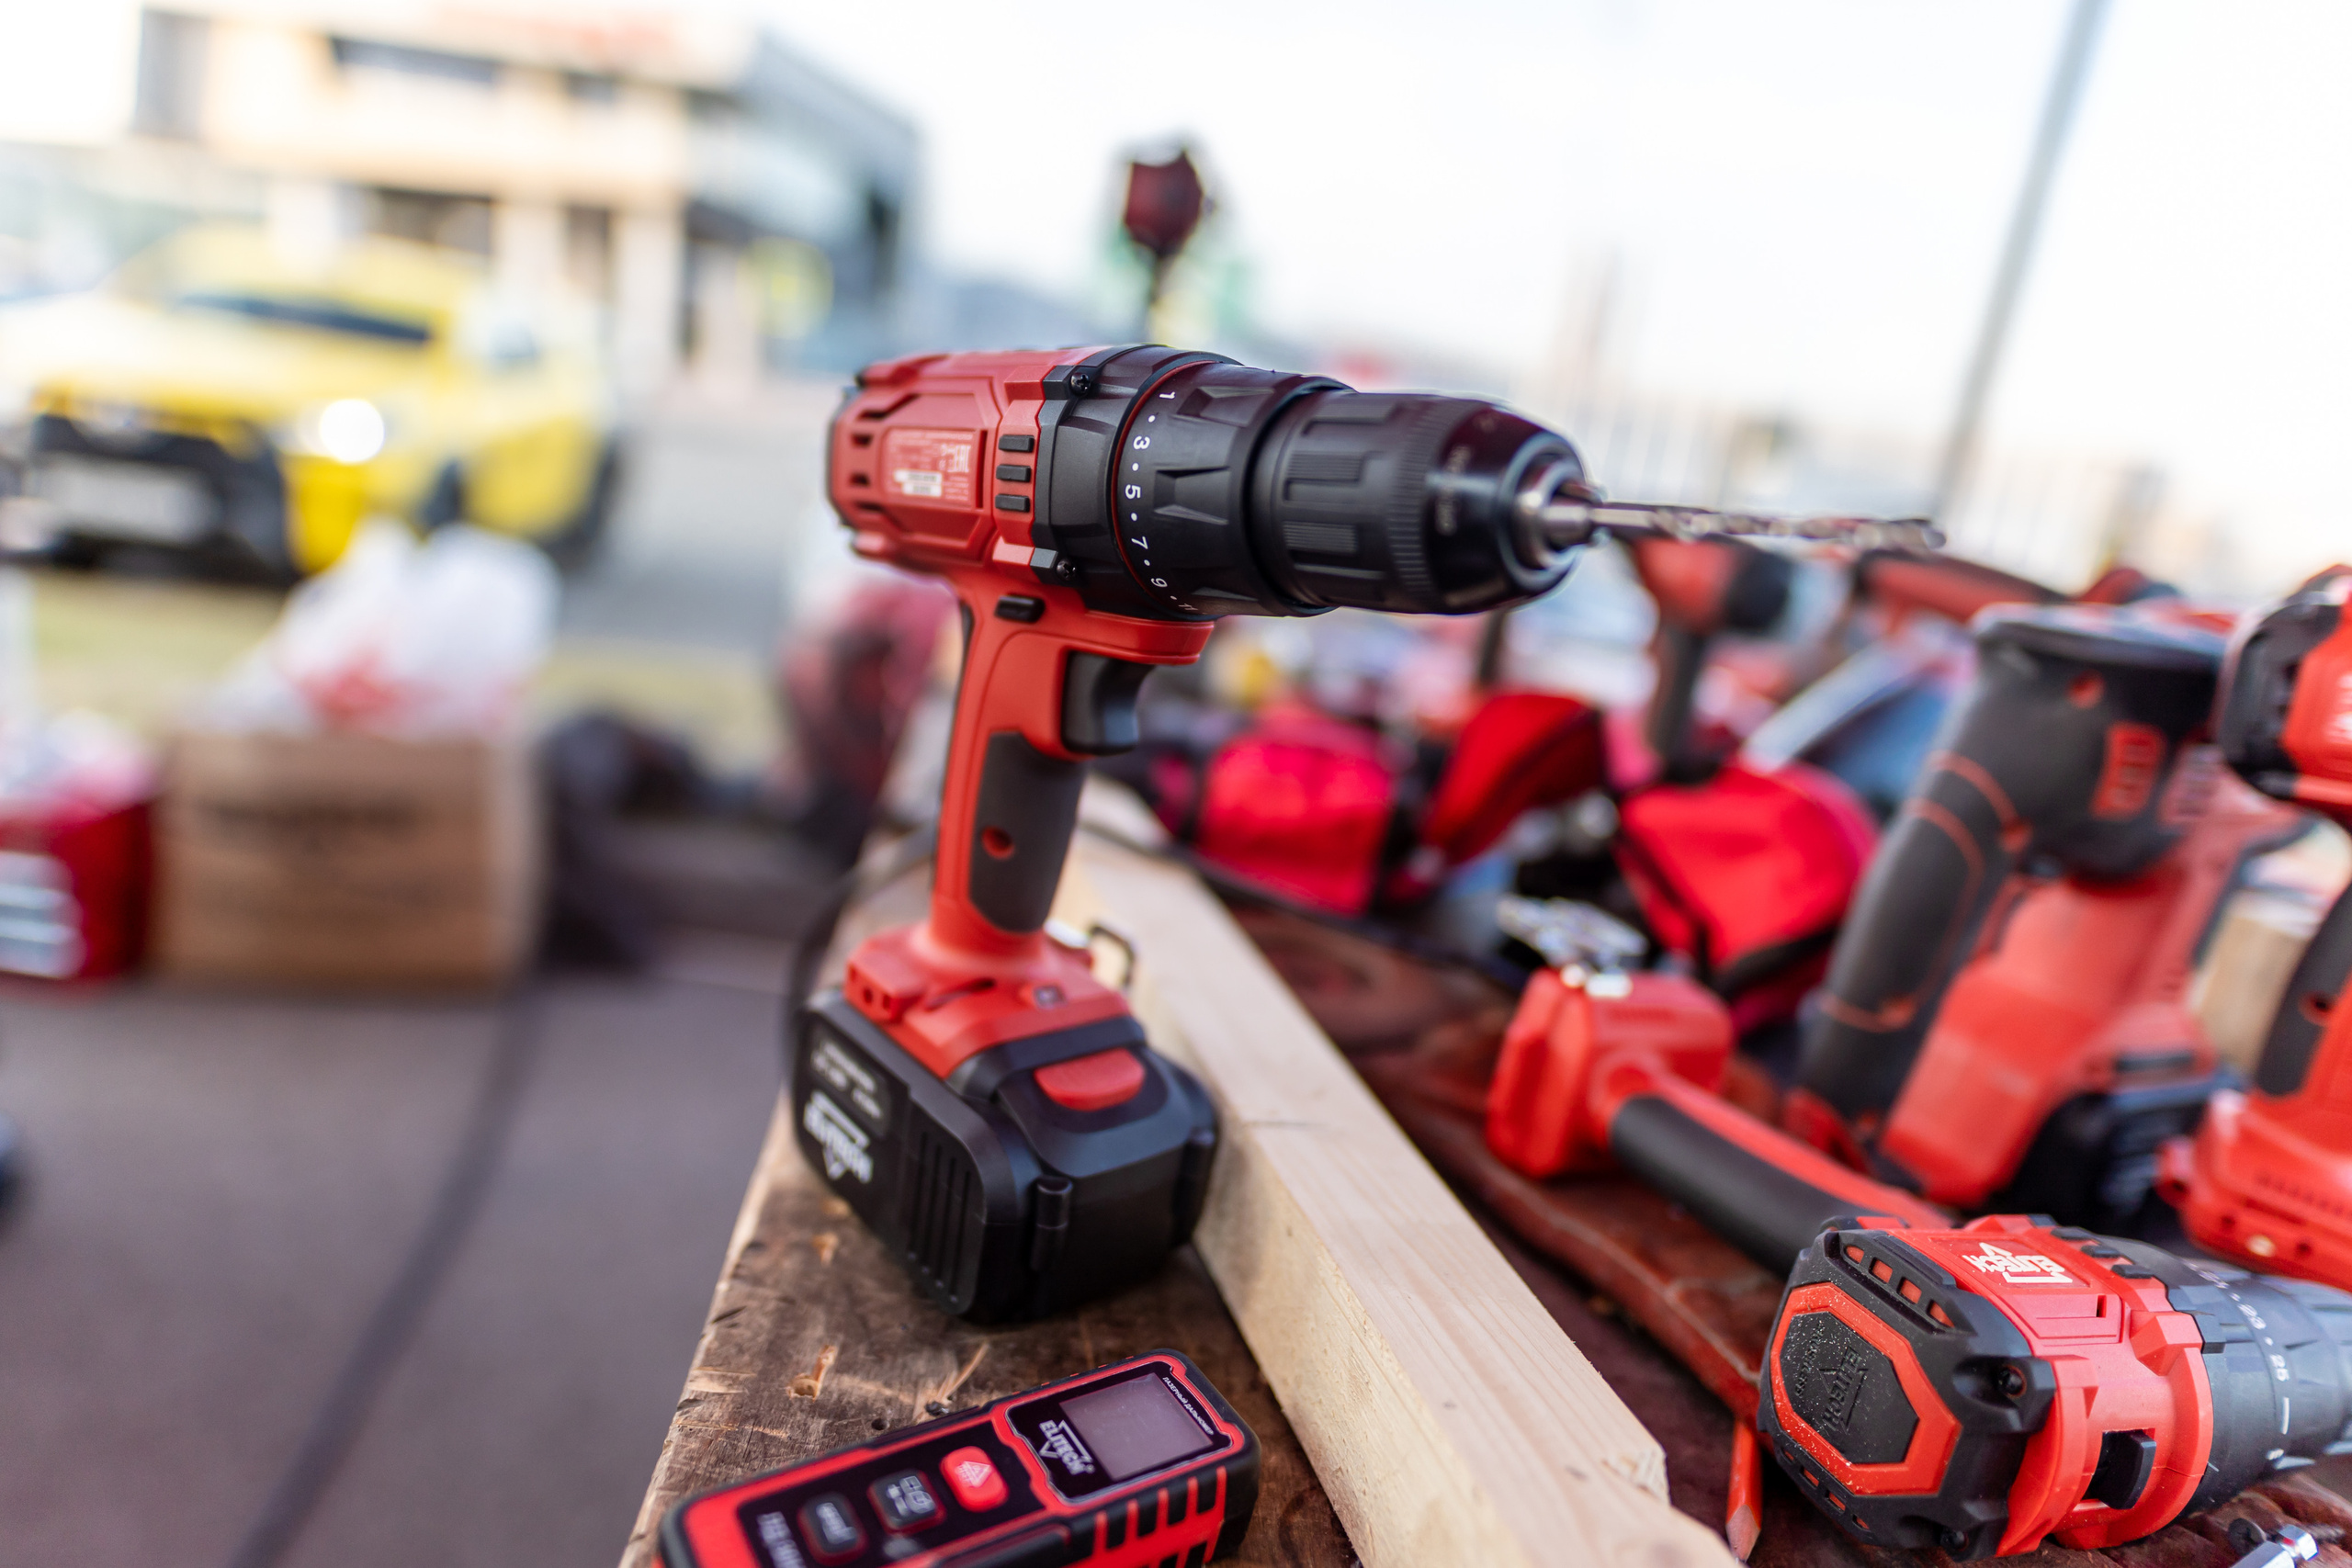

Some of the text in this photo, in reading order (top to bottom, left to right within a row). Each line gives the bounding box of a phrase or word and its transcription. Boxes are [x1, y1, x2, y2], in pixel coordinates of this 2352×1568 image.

[1133, 435, 1150, 450] 3
[1125, 485, 1141, 500] 5
[1131, 536, 1148, 549] 7
[1150, 578, 1168, 588] 9
[2237, 1303, 2267, 1330] 23
[2269, 1353, 2290, 1382] 25
[1162, 1376, 1214, 1435] ЛАЗЕРНЫЙ ДАЛЬНОМЕР
[1821, 1346, 1862, 1432] ELITECH
[1039, 1419, 1085, 1475] ELITECH
